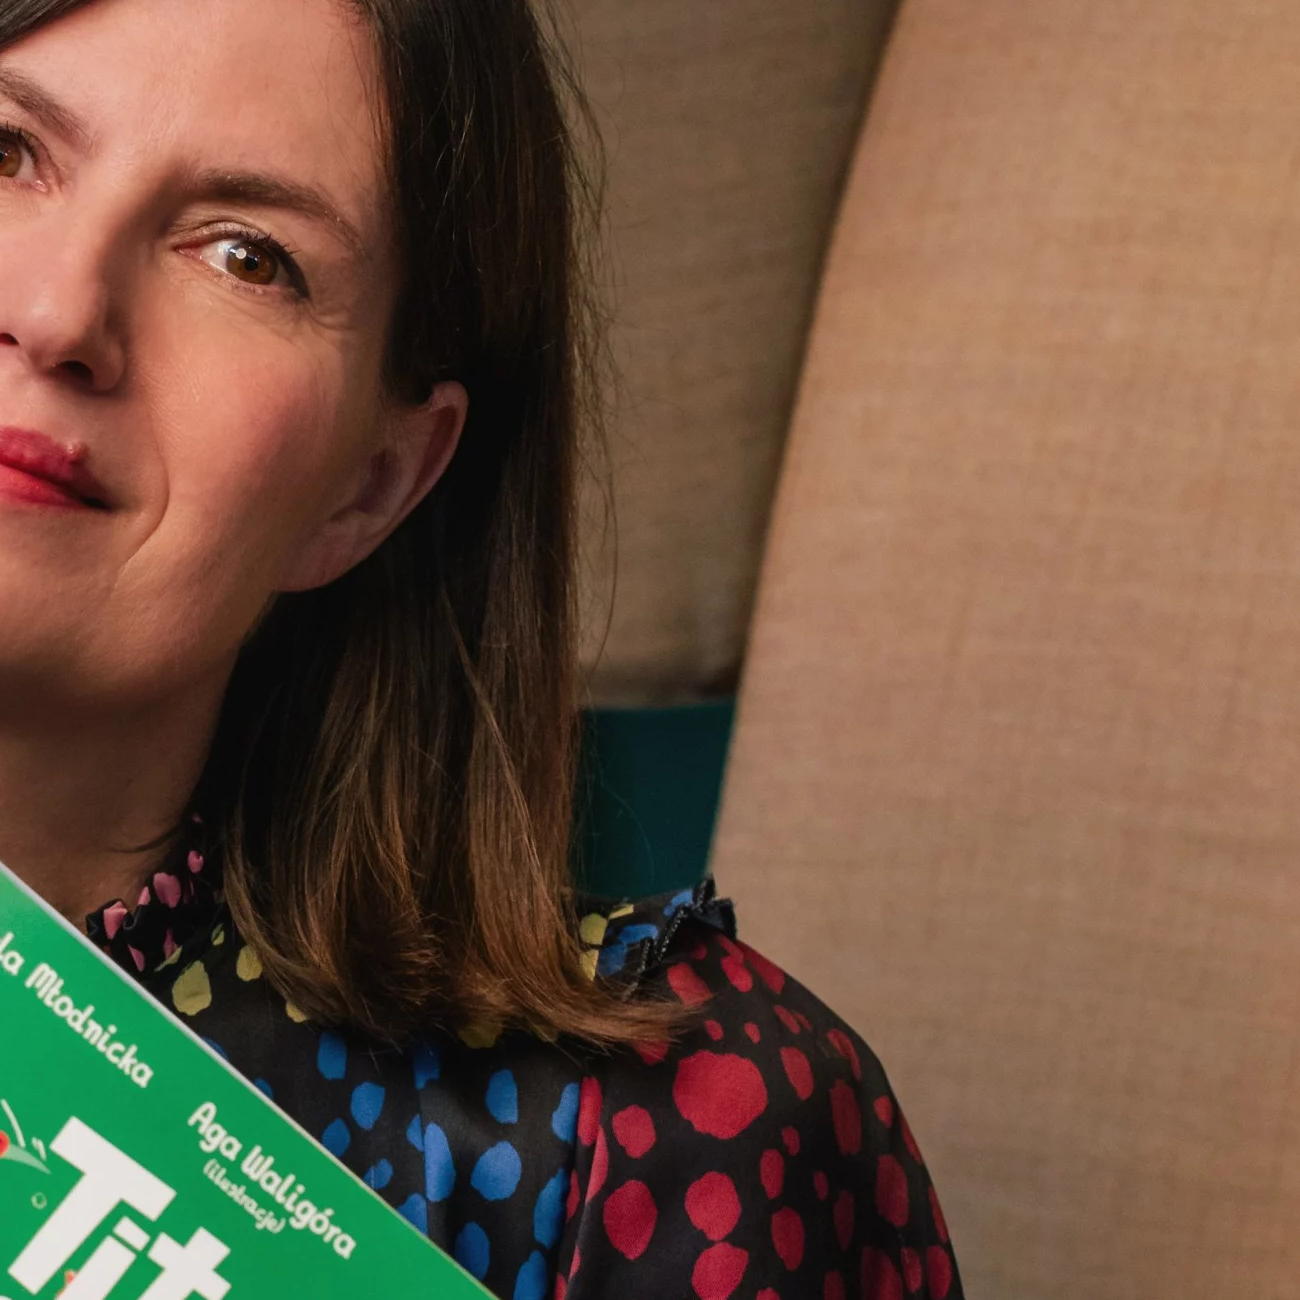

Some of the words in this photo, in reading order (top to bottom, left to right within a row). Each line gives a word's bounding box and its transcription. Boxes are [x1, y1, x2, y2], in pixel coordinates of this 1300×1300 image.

[25, 962, 155, 1088] Młodnicka
[187, 1101, 243, 1162] Aga
[240, 1144, 358, 1260] Waligóra
[203, 1157, 287, 1234] (ilustracje)
